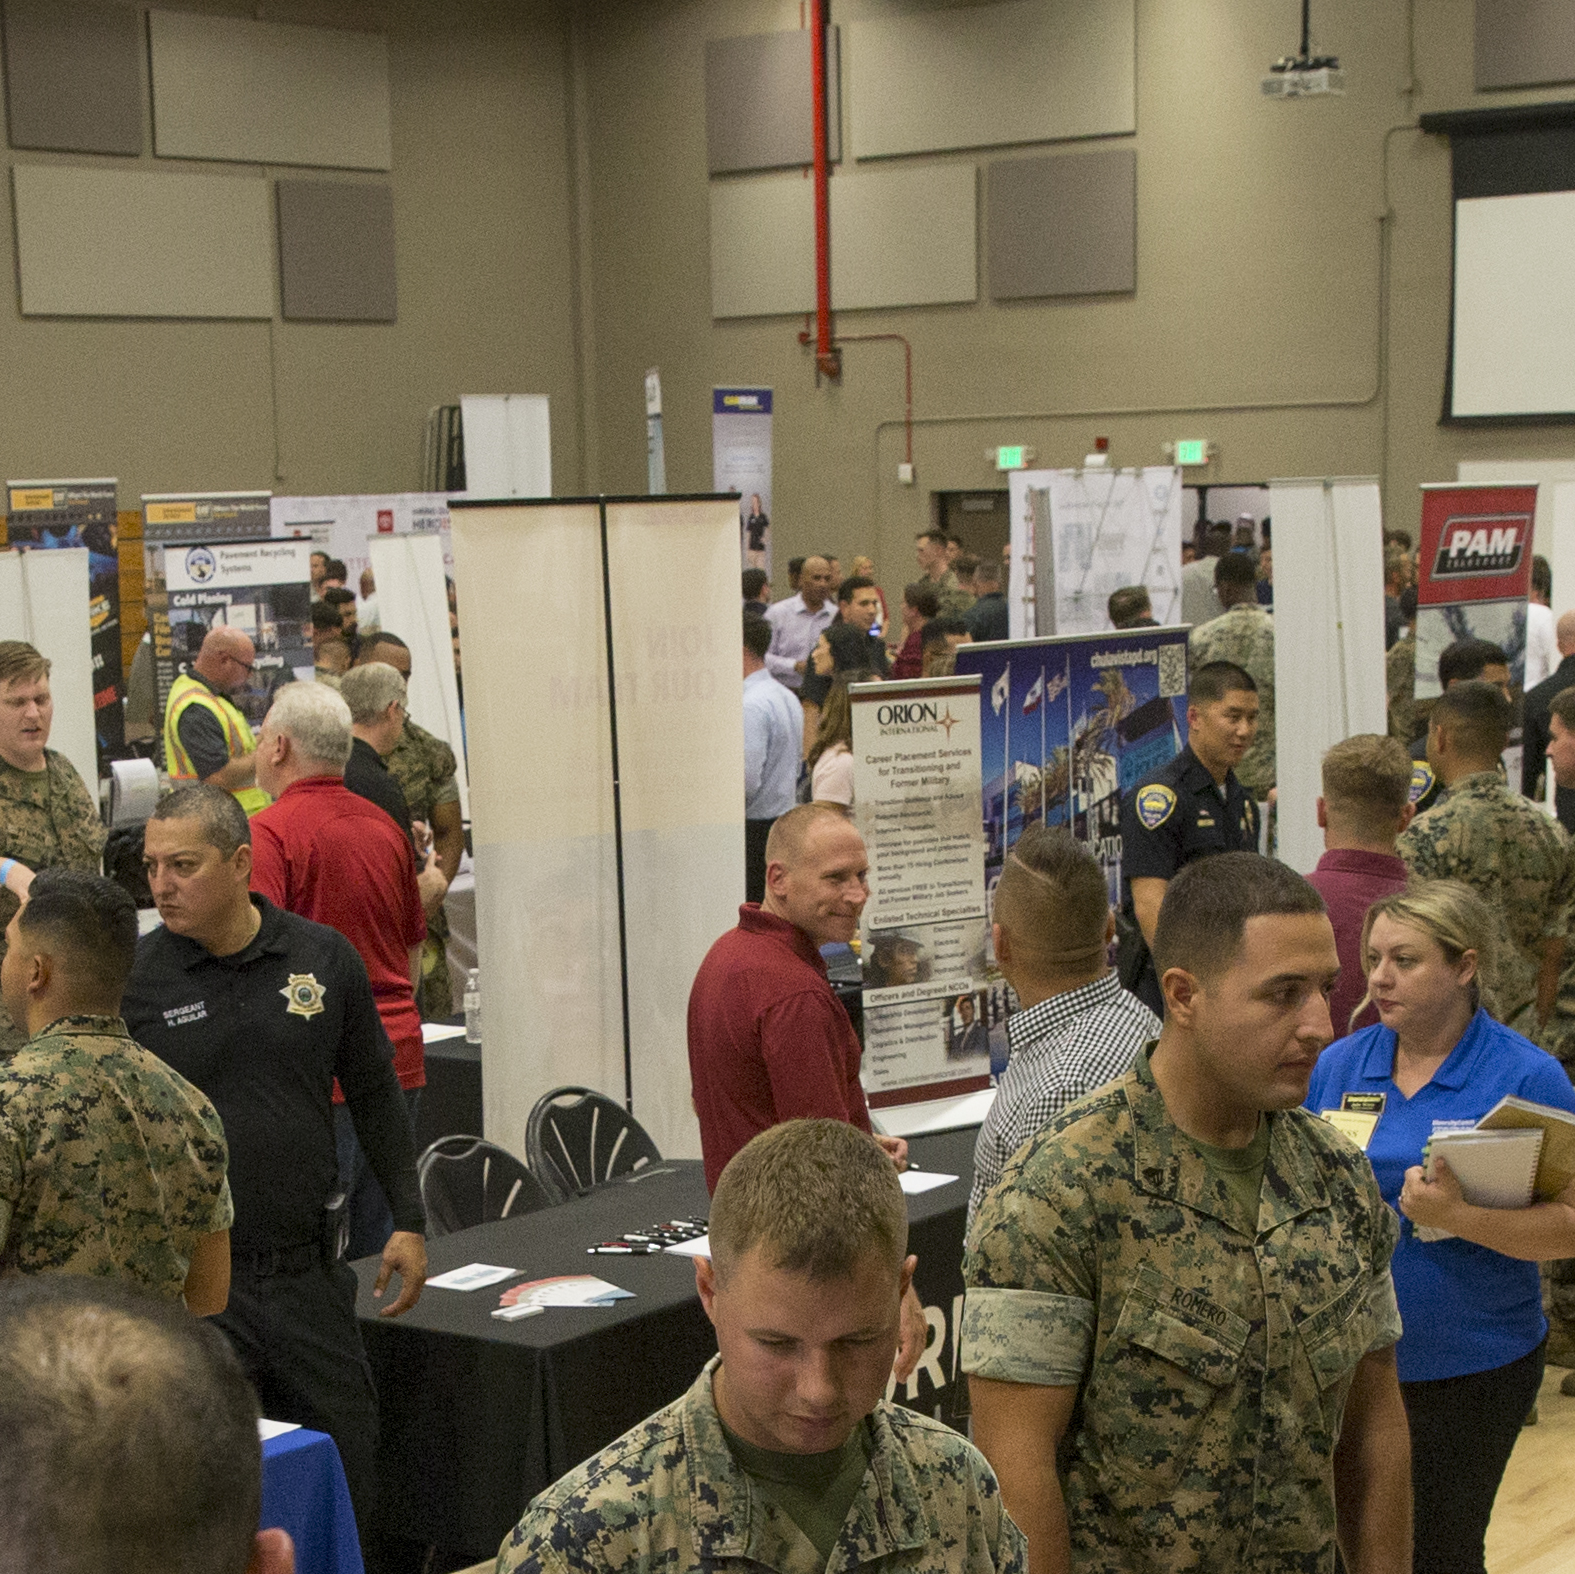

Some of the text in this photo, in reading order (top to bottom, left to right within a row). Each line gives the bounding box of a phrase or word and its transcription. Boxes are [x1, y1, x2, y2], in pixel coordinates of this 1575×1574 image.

[1449, 527, 1517, 558] PAM
[221, 564, 252, 576] Systems
[878, 702, 937, 726] ORION
[880, 726, 938, 736] INTERNATIONAL
[866, 747, 972, 764] Career Placement Services
[878, 762, 960, 776] for Transitioning and
[890, 776, 950, 788] Former Military
[874, 906, 981, 924] Enlisted Technical Specialties
[870, 981, 969, 1002] Officers and Degreed NCOs
[162, 1001, 204, 1019] SERGEANT
[178, 1010, 207, 1025] AGUILAR
[1171, 1287, 1227, 1326] ROMERO
